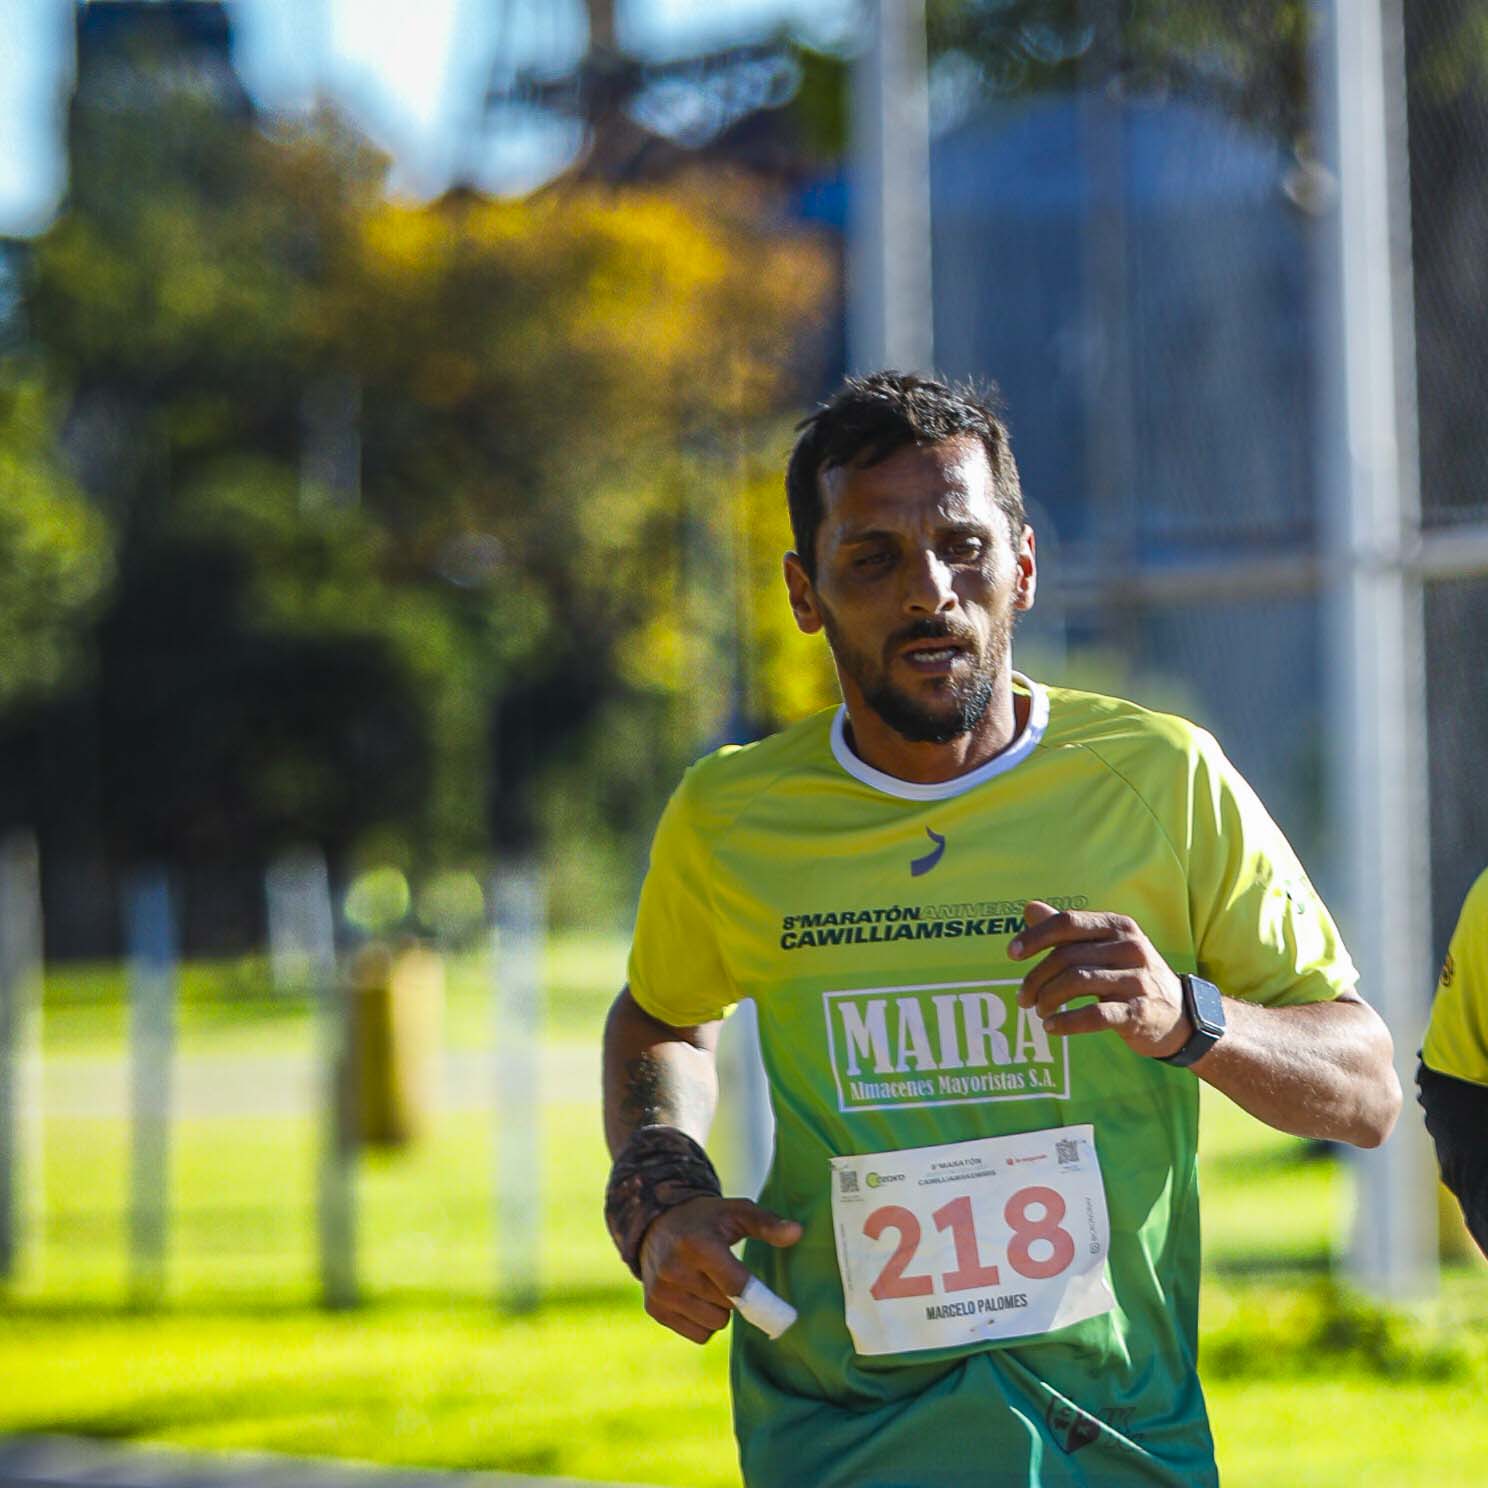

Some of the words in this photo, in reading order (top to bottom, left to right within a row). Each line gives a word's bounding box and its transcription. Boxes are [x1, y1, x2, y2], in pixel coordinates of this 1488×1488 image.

[838, 992, 1054, 1076] MAIRA
[850, 1079, 934, 1100] Almacenes
[937, 1071, 1025, 1095] Mayoristas
[1029, 1068, 1056, 1088] S.A.
[863, 1186, 1075, 1300] 218
[926, 1300, 976, 1320] MARCELO
[977, 1293, 1028, 1313] PALOMES
